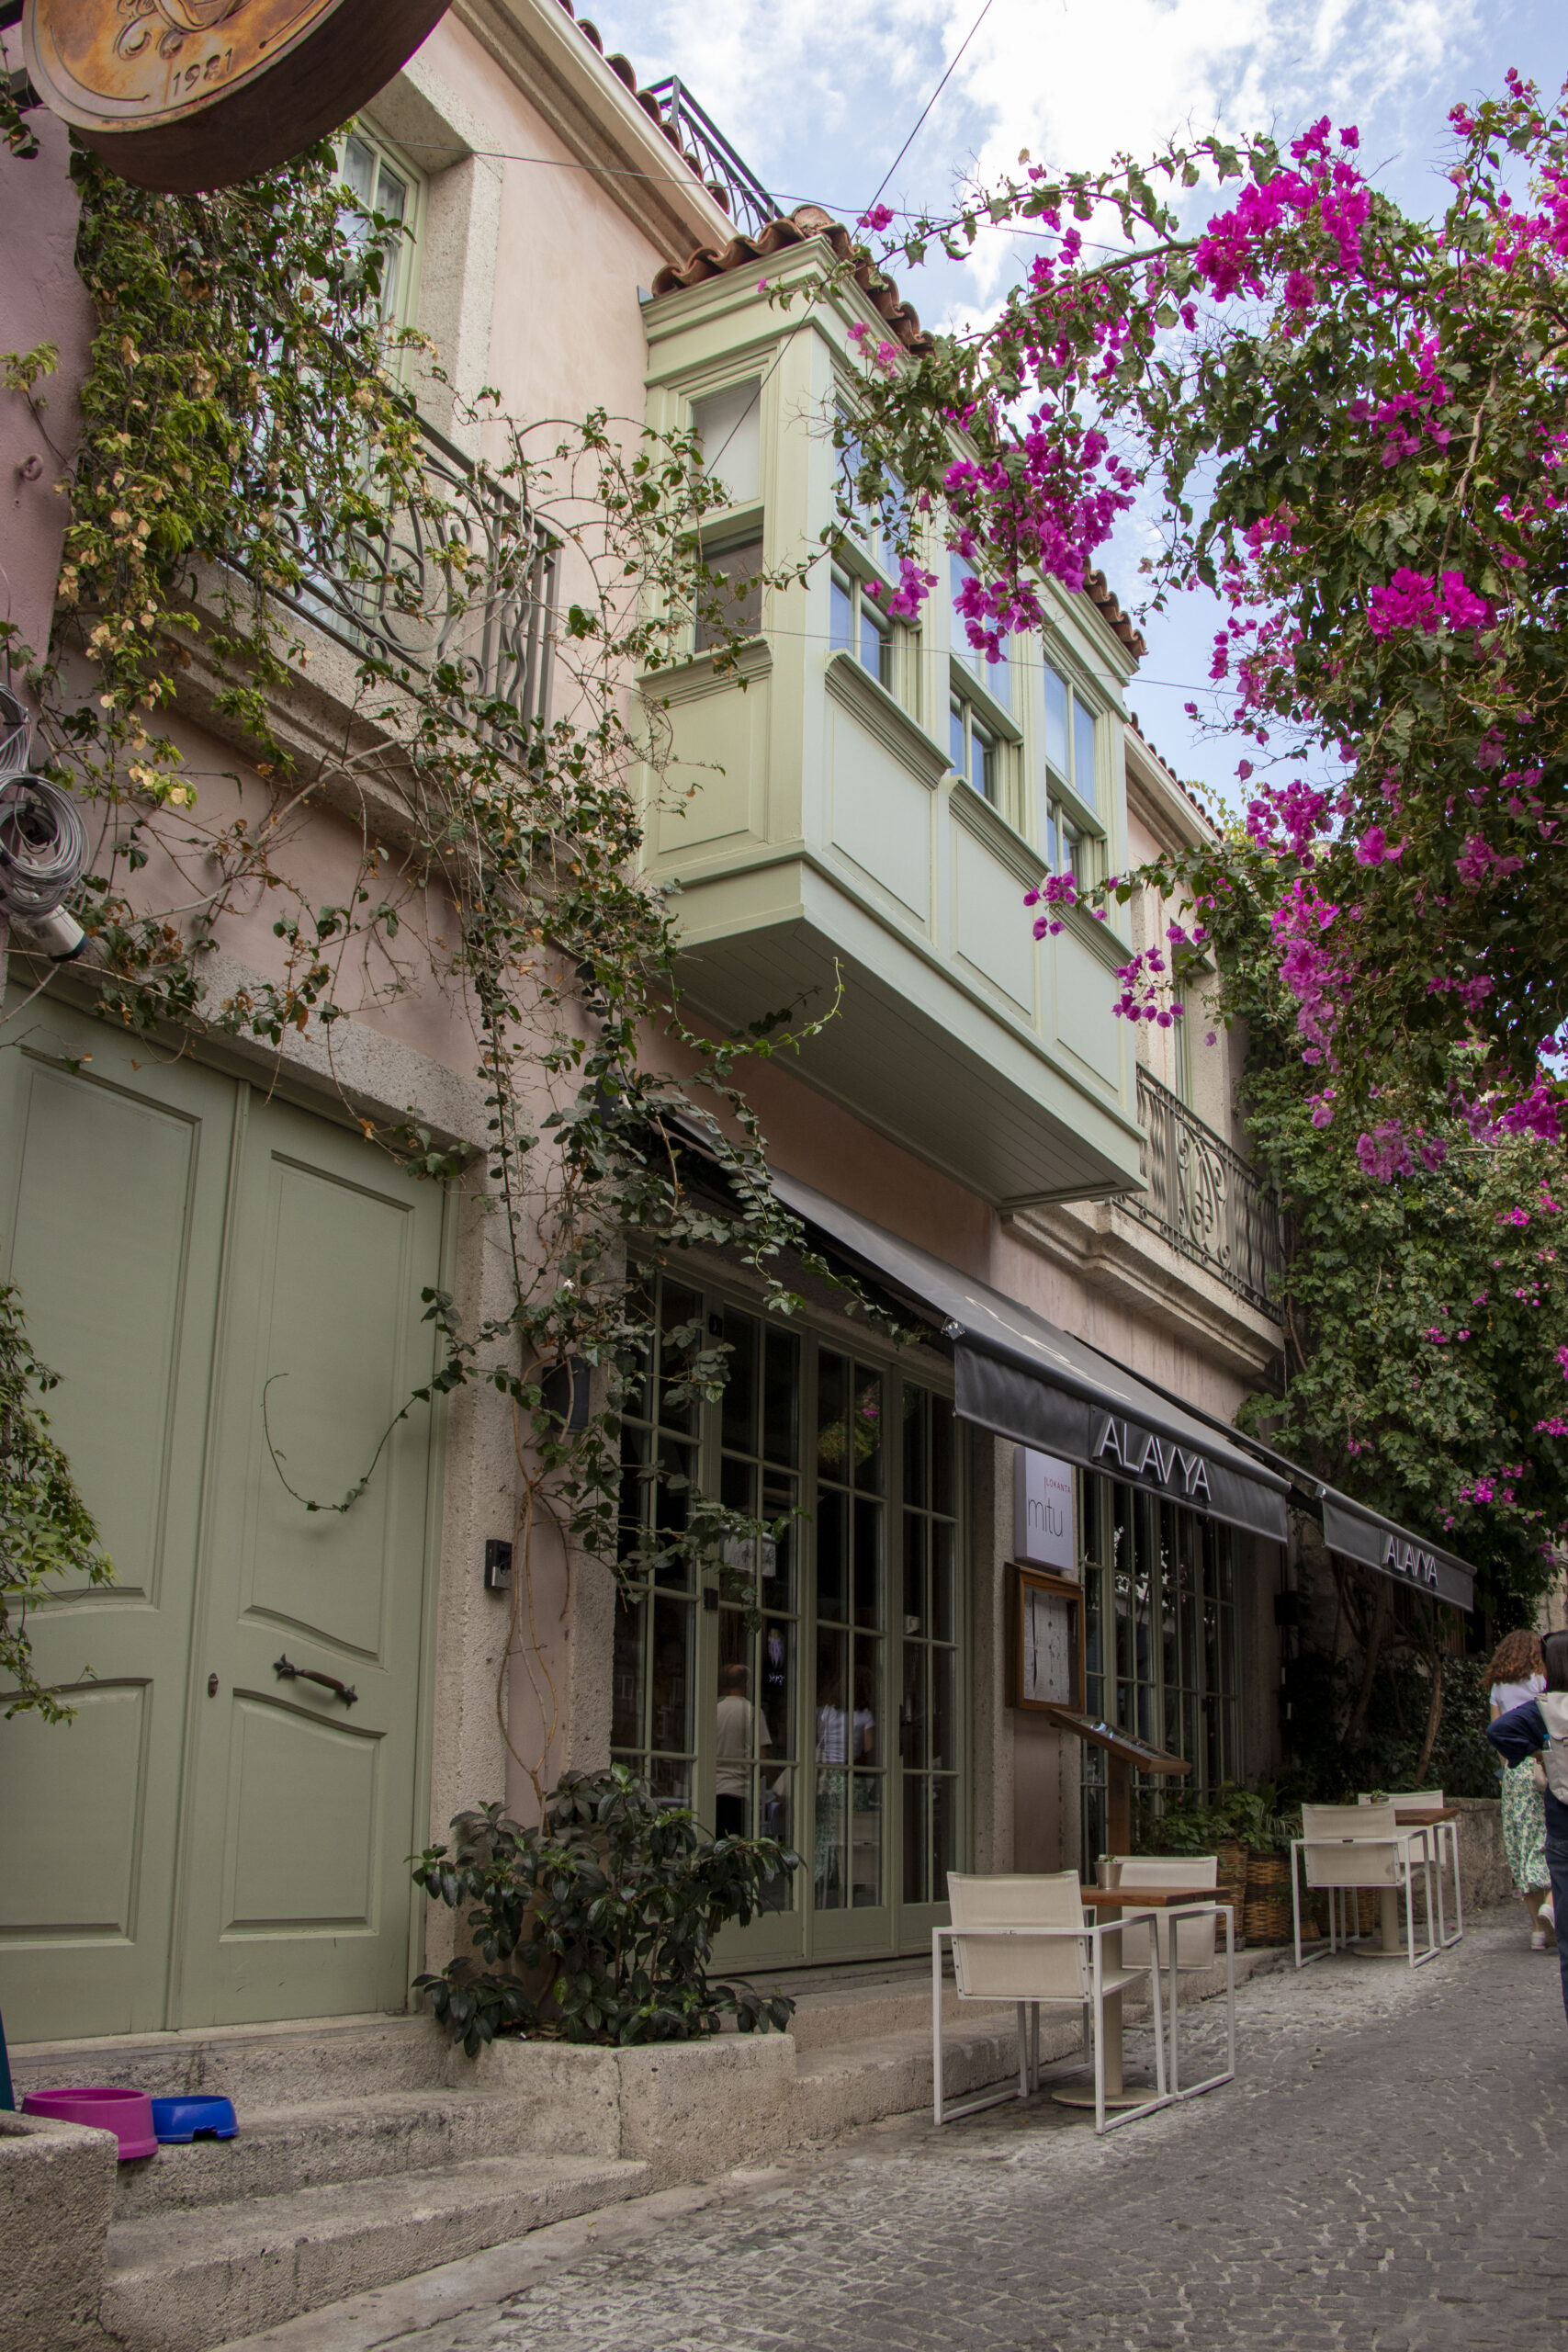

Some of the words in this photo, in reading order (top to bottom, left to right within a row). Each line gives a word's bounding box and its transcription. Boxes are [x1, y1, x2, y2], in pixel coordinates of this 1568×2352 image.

[173, 47, 232, 96] 1981
[1098, 1416, 1212, 1502] ALAVYA
[1045, 1477, 1071, 1494] LOKANTA
[1028, 1498, 1064, 1537] mitu
[1385, 1534, 1439, 1589] ALAVYA
